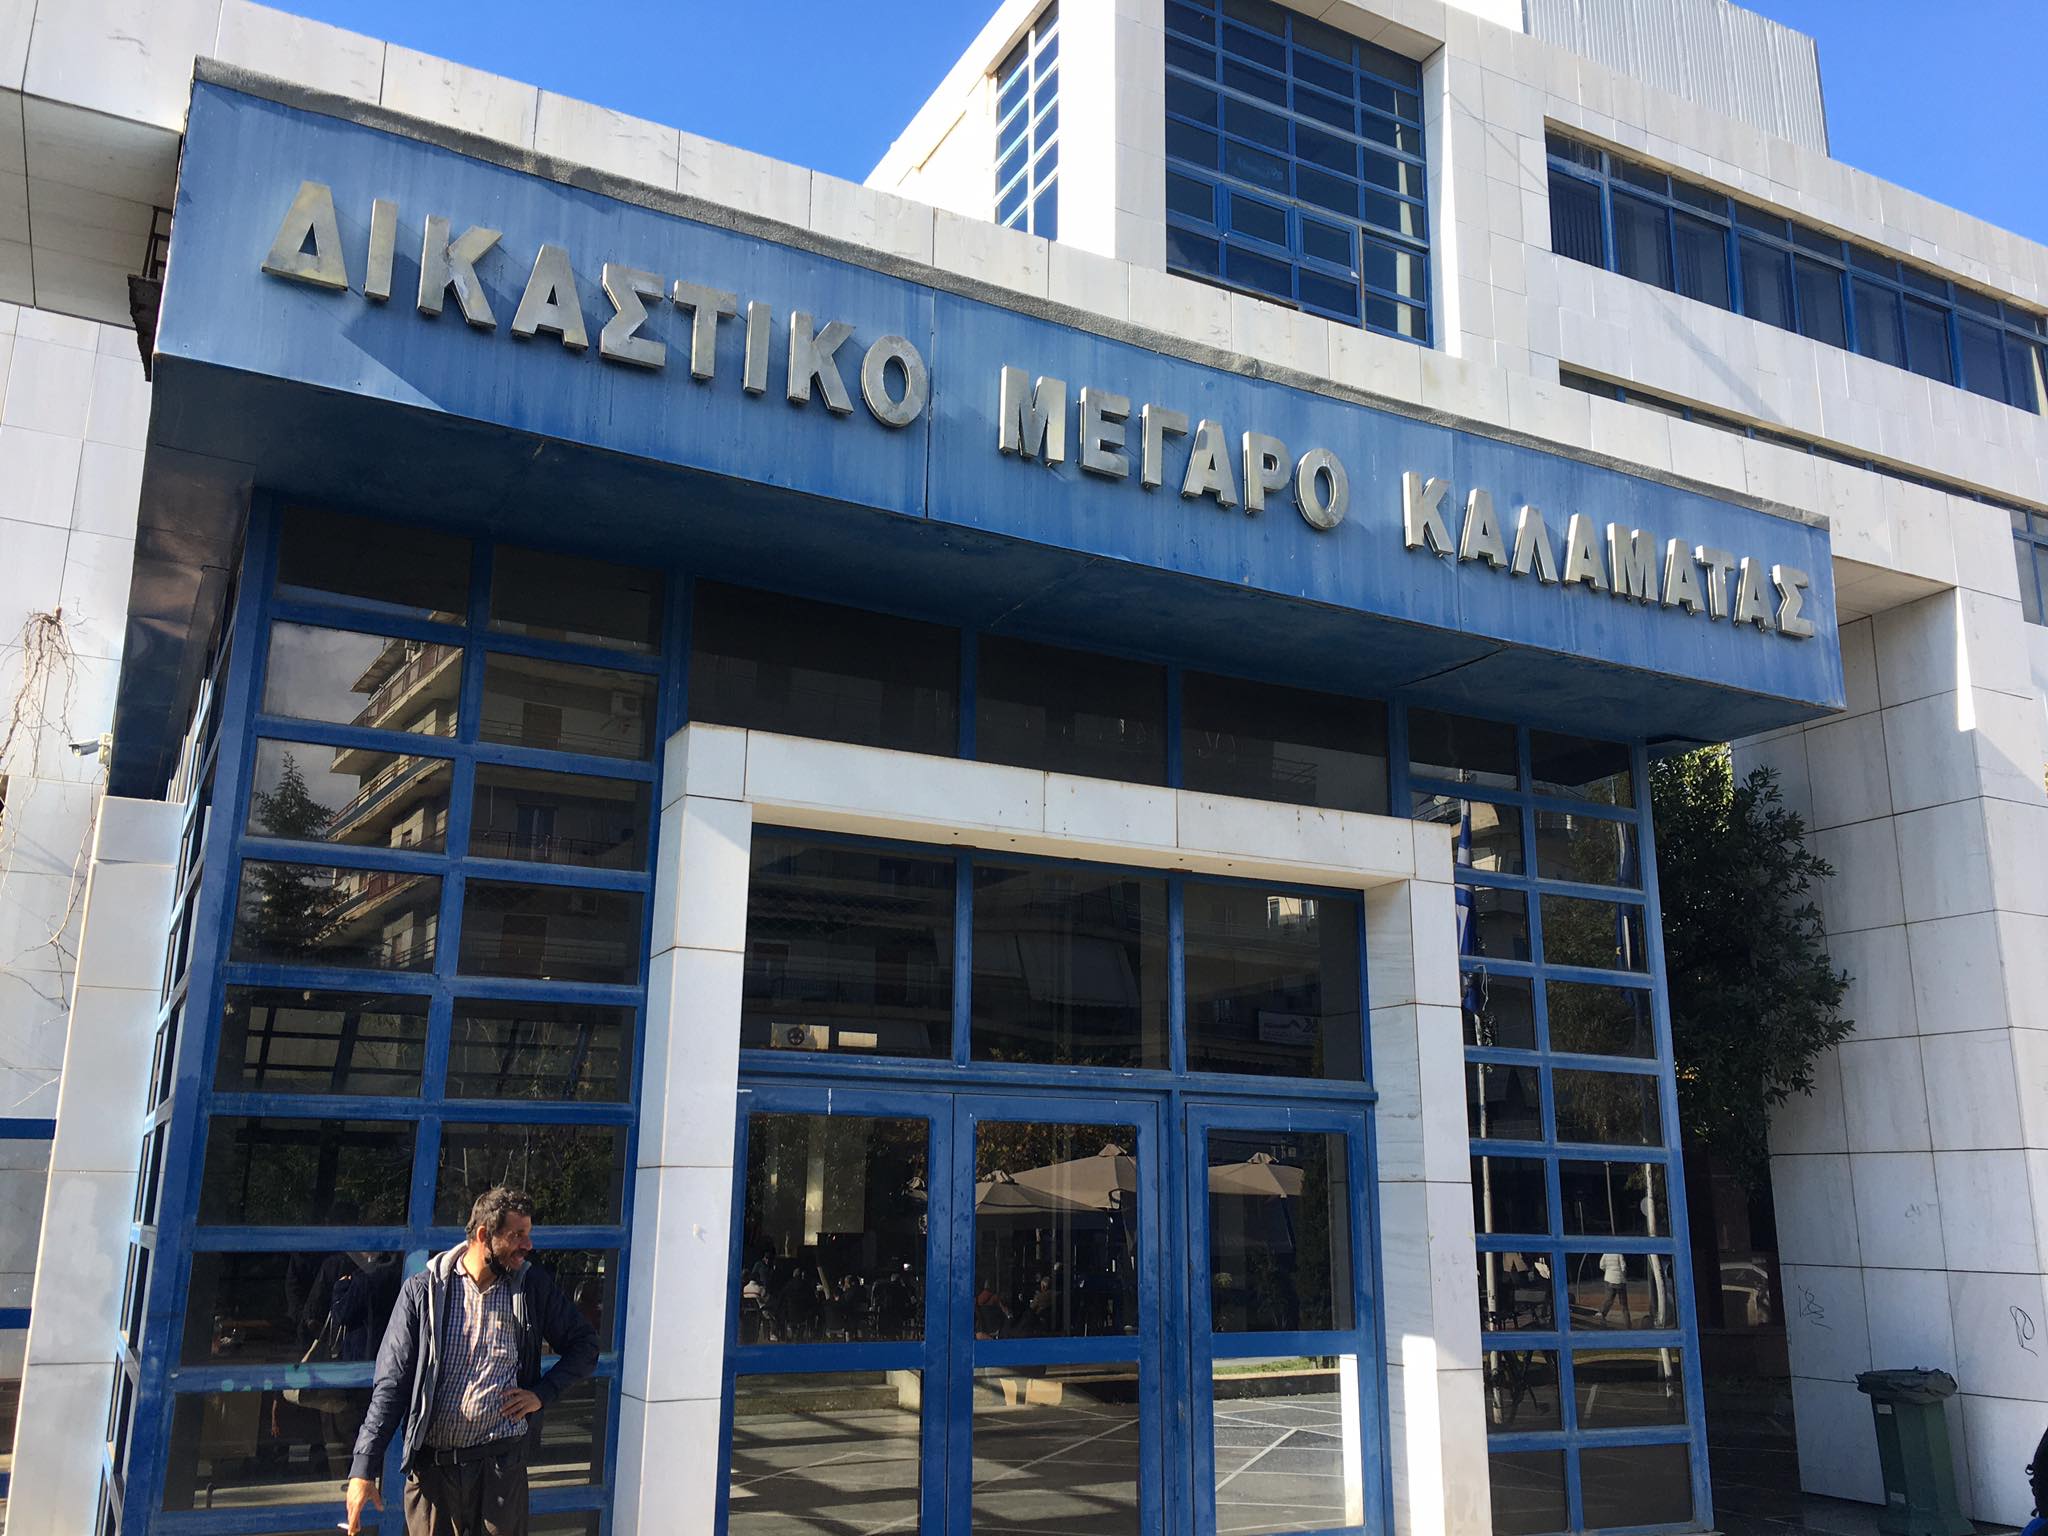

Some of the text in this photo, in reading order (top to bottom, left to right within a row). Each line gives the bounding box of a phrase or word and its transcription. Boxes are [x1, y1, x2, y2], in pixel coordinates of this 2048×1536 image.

[261, 181, 1814, 639] ΔΙΚΑΣΤΙΚΟ ΜΕΓΑΡΟ ΚΑΛΑΜΑΤΑΣ
